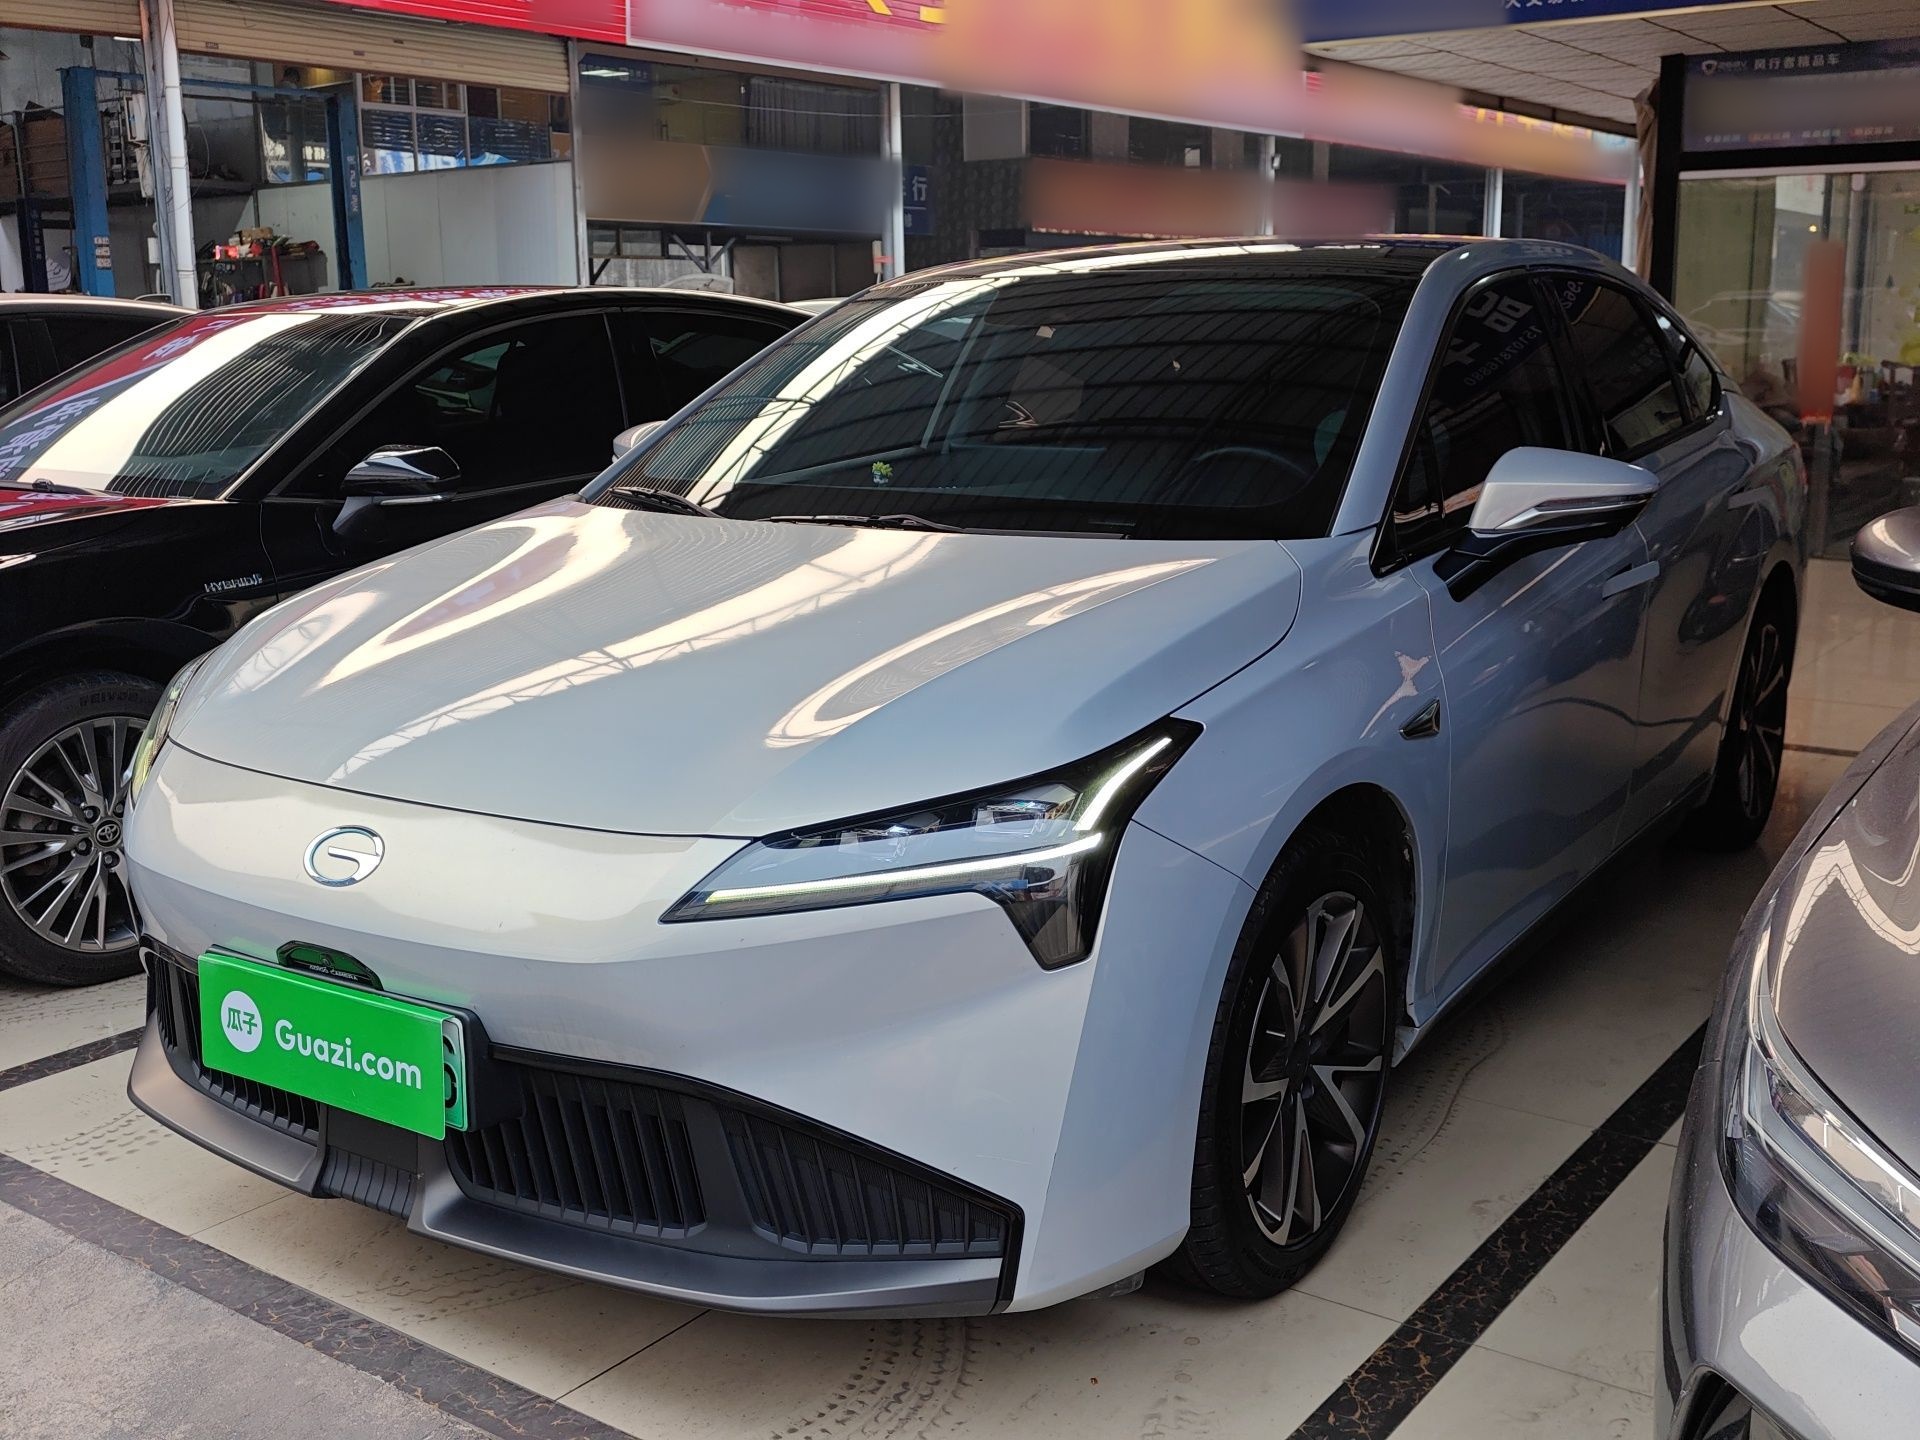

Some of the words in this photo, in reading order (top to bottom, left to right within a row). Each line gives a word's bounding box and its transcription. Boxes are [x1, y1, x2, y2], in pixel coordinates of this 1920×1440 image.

[204, 576, 253, 593] HYBRID
[227, 1007, 258, 1035] 瓜子
[274, 1019, 422, 1090] Guazi.com
